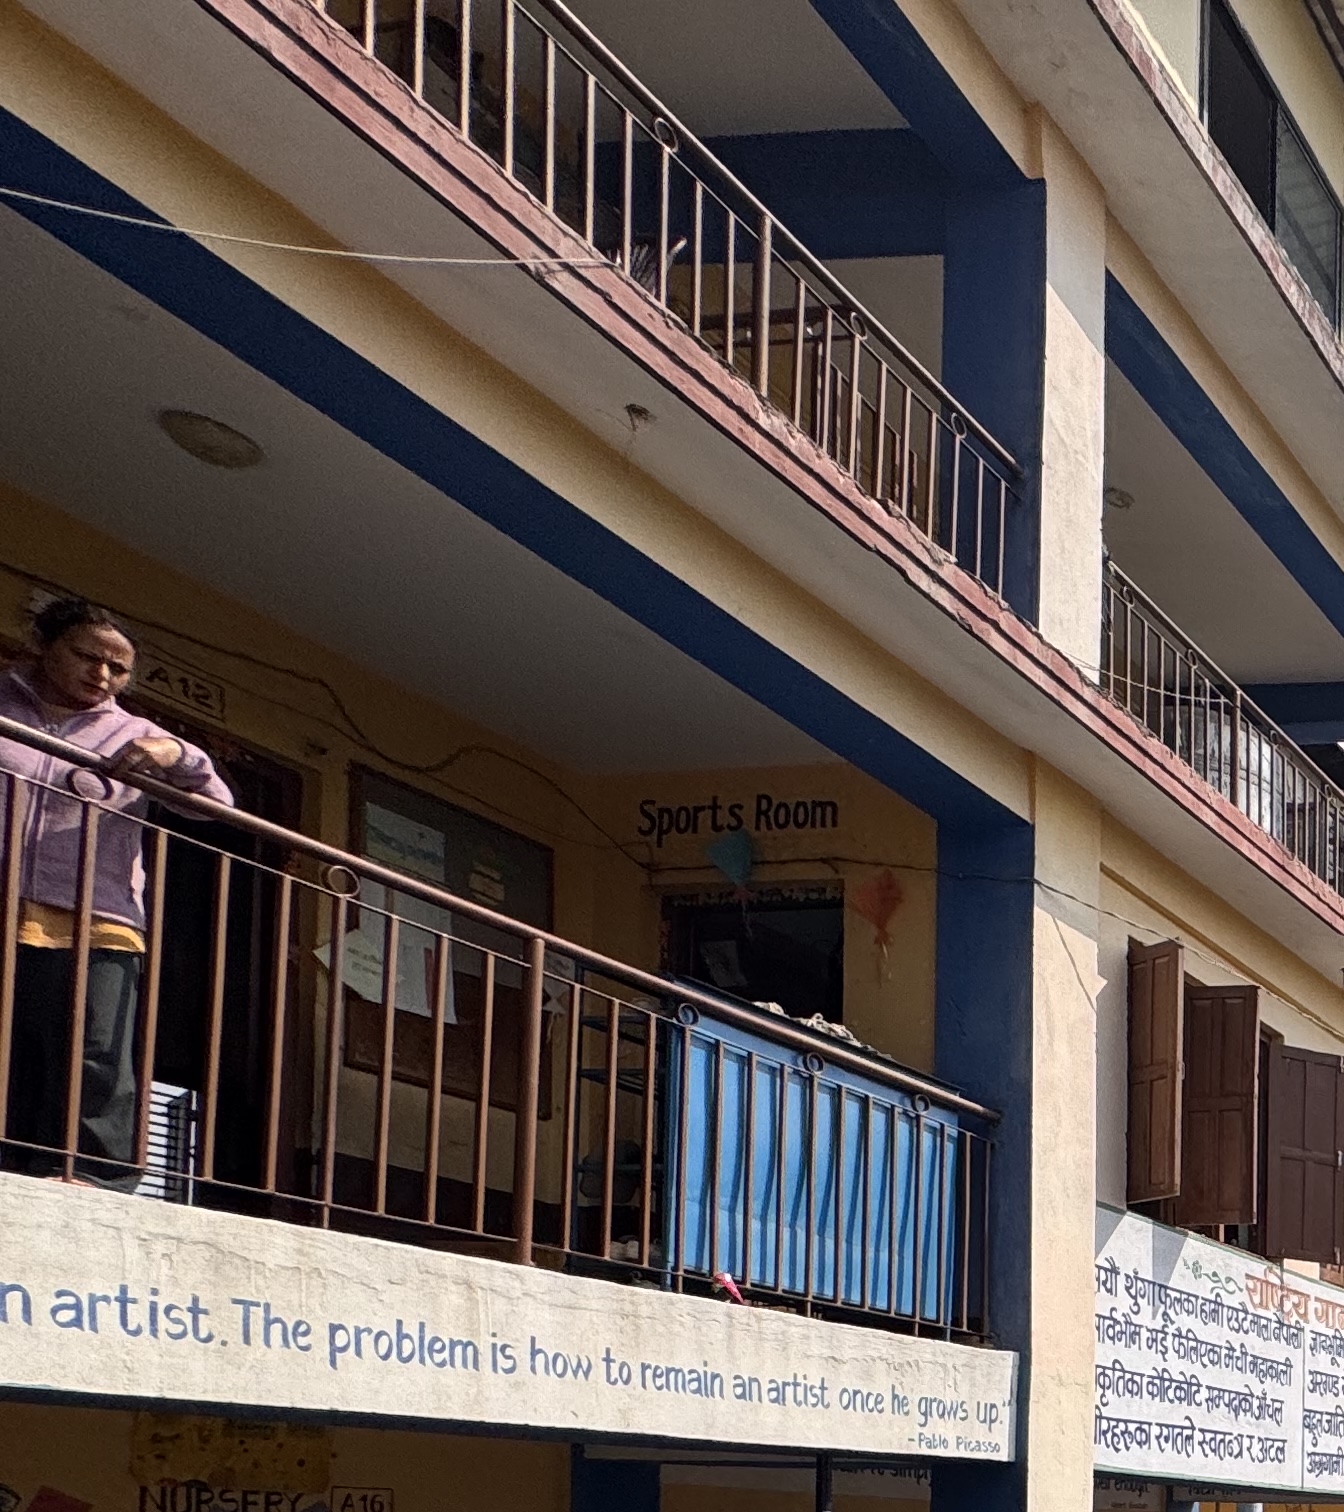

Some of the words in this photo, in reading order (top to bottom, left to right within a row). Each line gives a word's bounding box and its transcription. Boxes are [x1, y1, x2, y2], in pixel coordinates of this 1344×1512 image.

[637, 795, 744, 848] Sports
[754, 794, 839, 832] Room
[1200, 1292, 1224, 1328] हामी
[1273, 1313, 1304, 1349] नेपाली
[50, 1284, 228, 1347] artist.
[230, 1297, 312, 1352] The
[328, 1319, 480, 1371] problem
[491, 1332, 517, 1375] is
[530, 1336, 593, 1381] how
[601, 1347, 632, 1386] to
[640, 1361, 724, 1400] remain
[732, 1373, 762, 1401] an
[767, 1373, 831, 1409] artist
[839, 1385, 885, 1415] once
[891, 1385, 910, 1417] he
[917, 1396, 969, 1428] grows
[1249, 1354, 1294, 1387] महाकाली
[955, 1437, 1001, 1454] Picasso
[1155, 1415, 1196, 1458] रगतले
[1246, 1435, 1257, 1463] र
[1257, 1436, 1288, 1464] अटल
